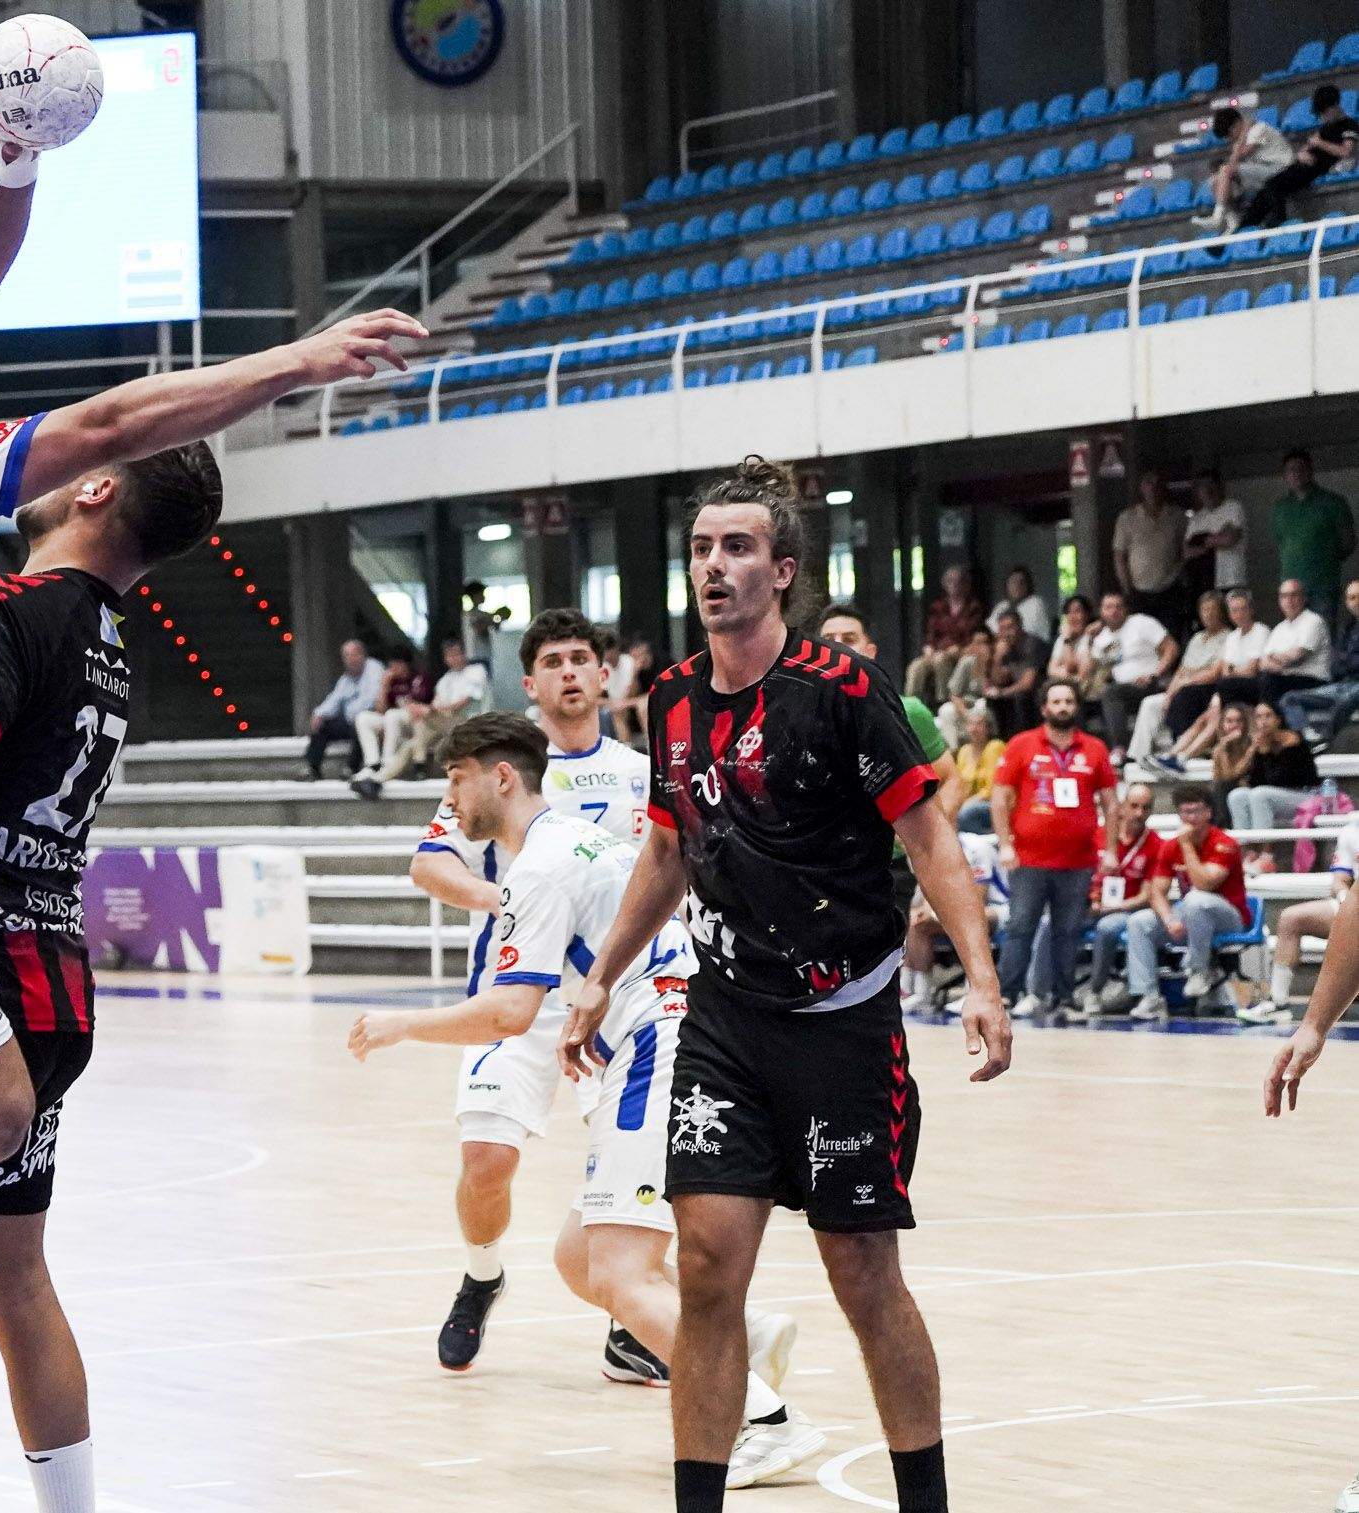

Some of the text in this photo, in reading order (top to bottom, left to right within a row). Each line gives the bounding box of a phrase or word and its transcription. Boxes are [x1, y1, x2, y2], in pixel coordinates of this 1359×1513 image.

[22, 705, 128, 838] 27
[575, 772, 618, 787] ence
[580, 803, 608, 824] 7
[672, 1139, 722, 1155] LANZAROTE
[819, 1137, 860, 1151] Arrecife
